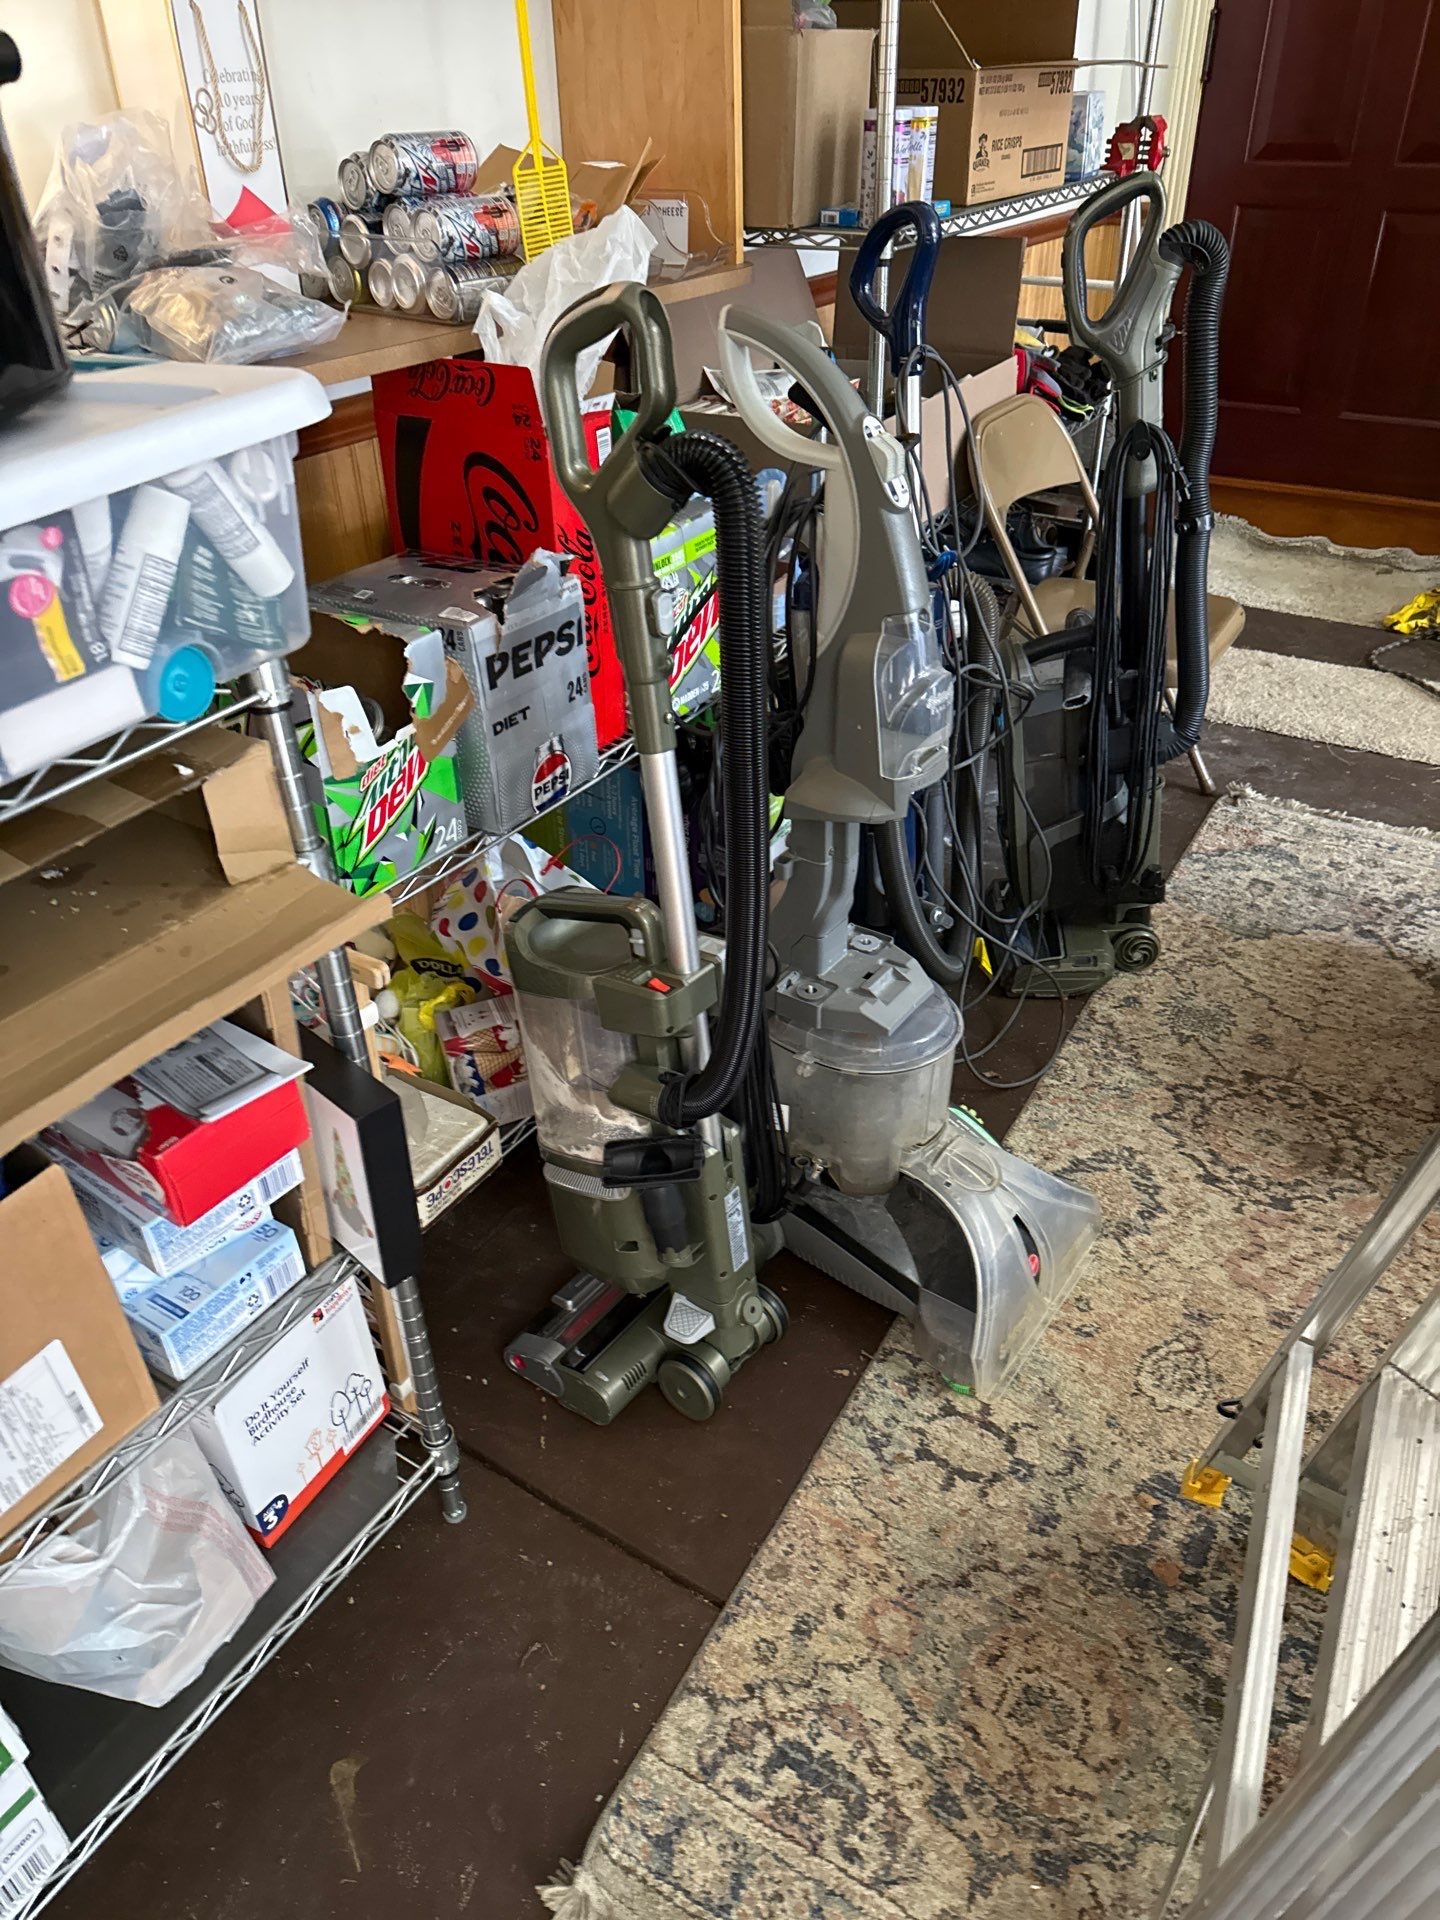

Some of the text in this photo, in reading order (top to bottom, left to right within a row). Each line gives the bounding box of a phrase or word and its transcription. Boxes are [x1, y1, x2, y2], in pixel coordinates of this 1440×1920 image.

[920, 77, 965, 104] 57932
[991, 138, 1004, 152] RICE
[485, 614, 584, 691] PEPSI
[567, 675, 583, 703] 24
[492, 706, 531, 737] DIET
[534, 767, 570, 801] PEPSI
[434, 817, 458, 853] 24
[425, 1140, 494, 1208] TELESCOPE
[244, 1357, 311, 1428] Do It Yourself
[247, 1386, 298, 1437] Birdhouse
[251, 1388, 307, 1447] Activity Set
